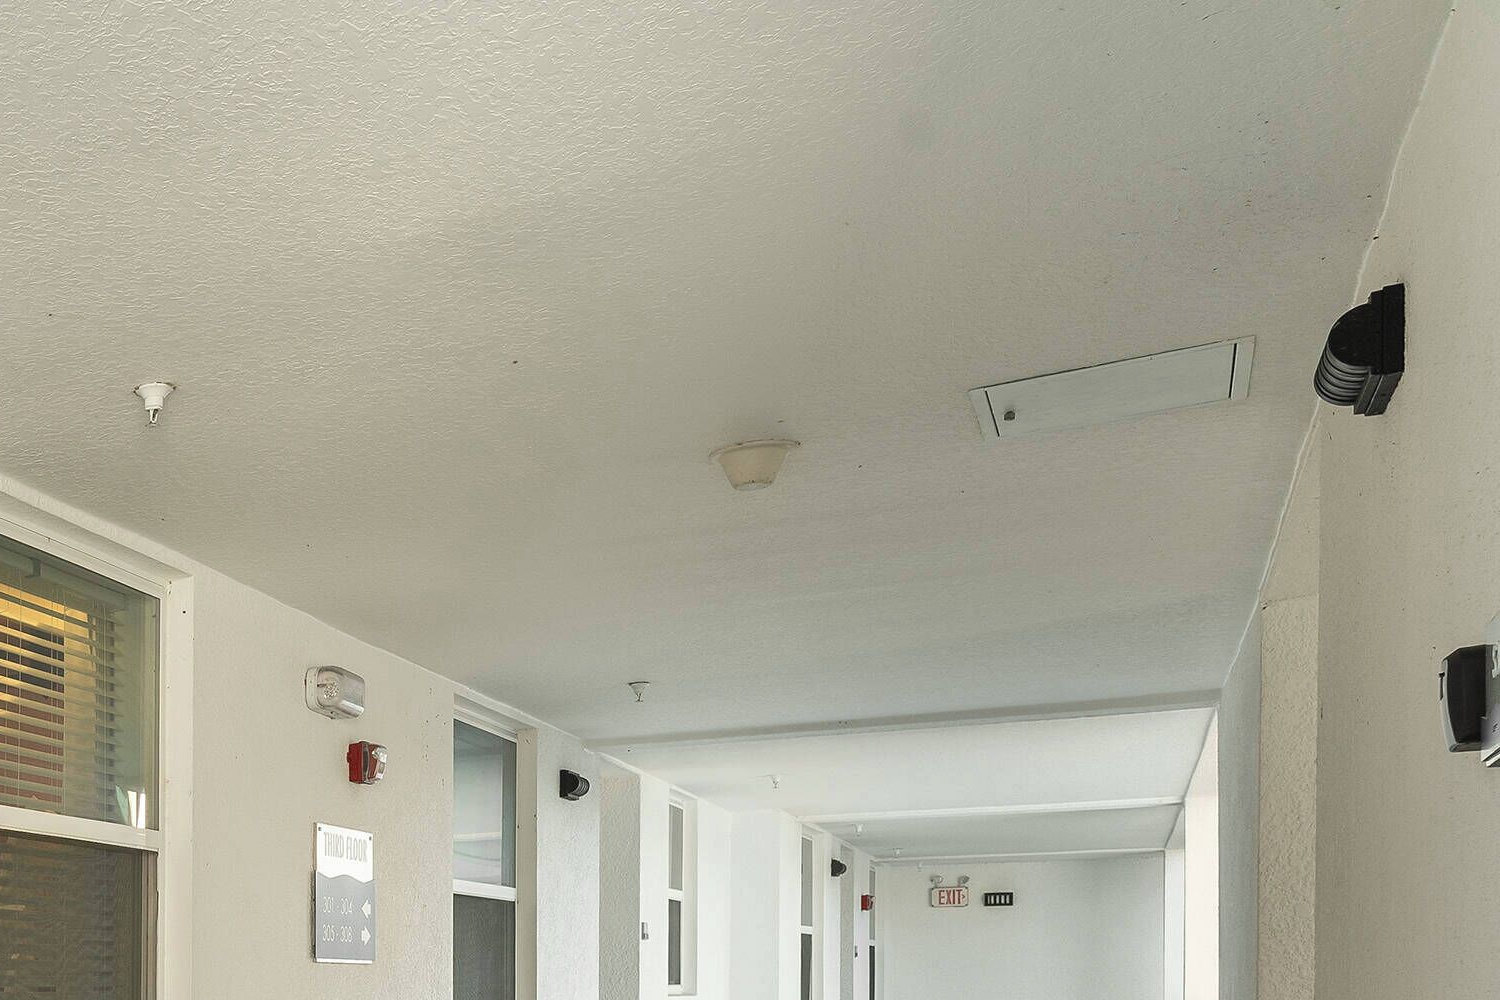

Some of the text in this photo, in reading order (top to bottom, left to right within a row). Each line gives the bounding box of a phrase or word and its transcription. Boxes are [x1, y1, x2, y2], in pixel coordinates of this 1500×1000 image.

[324, 832, 368, 862] THIRD FLOOR
[938, 889, 963, 905] EXIT
